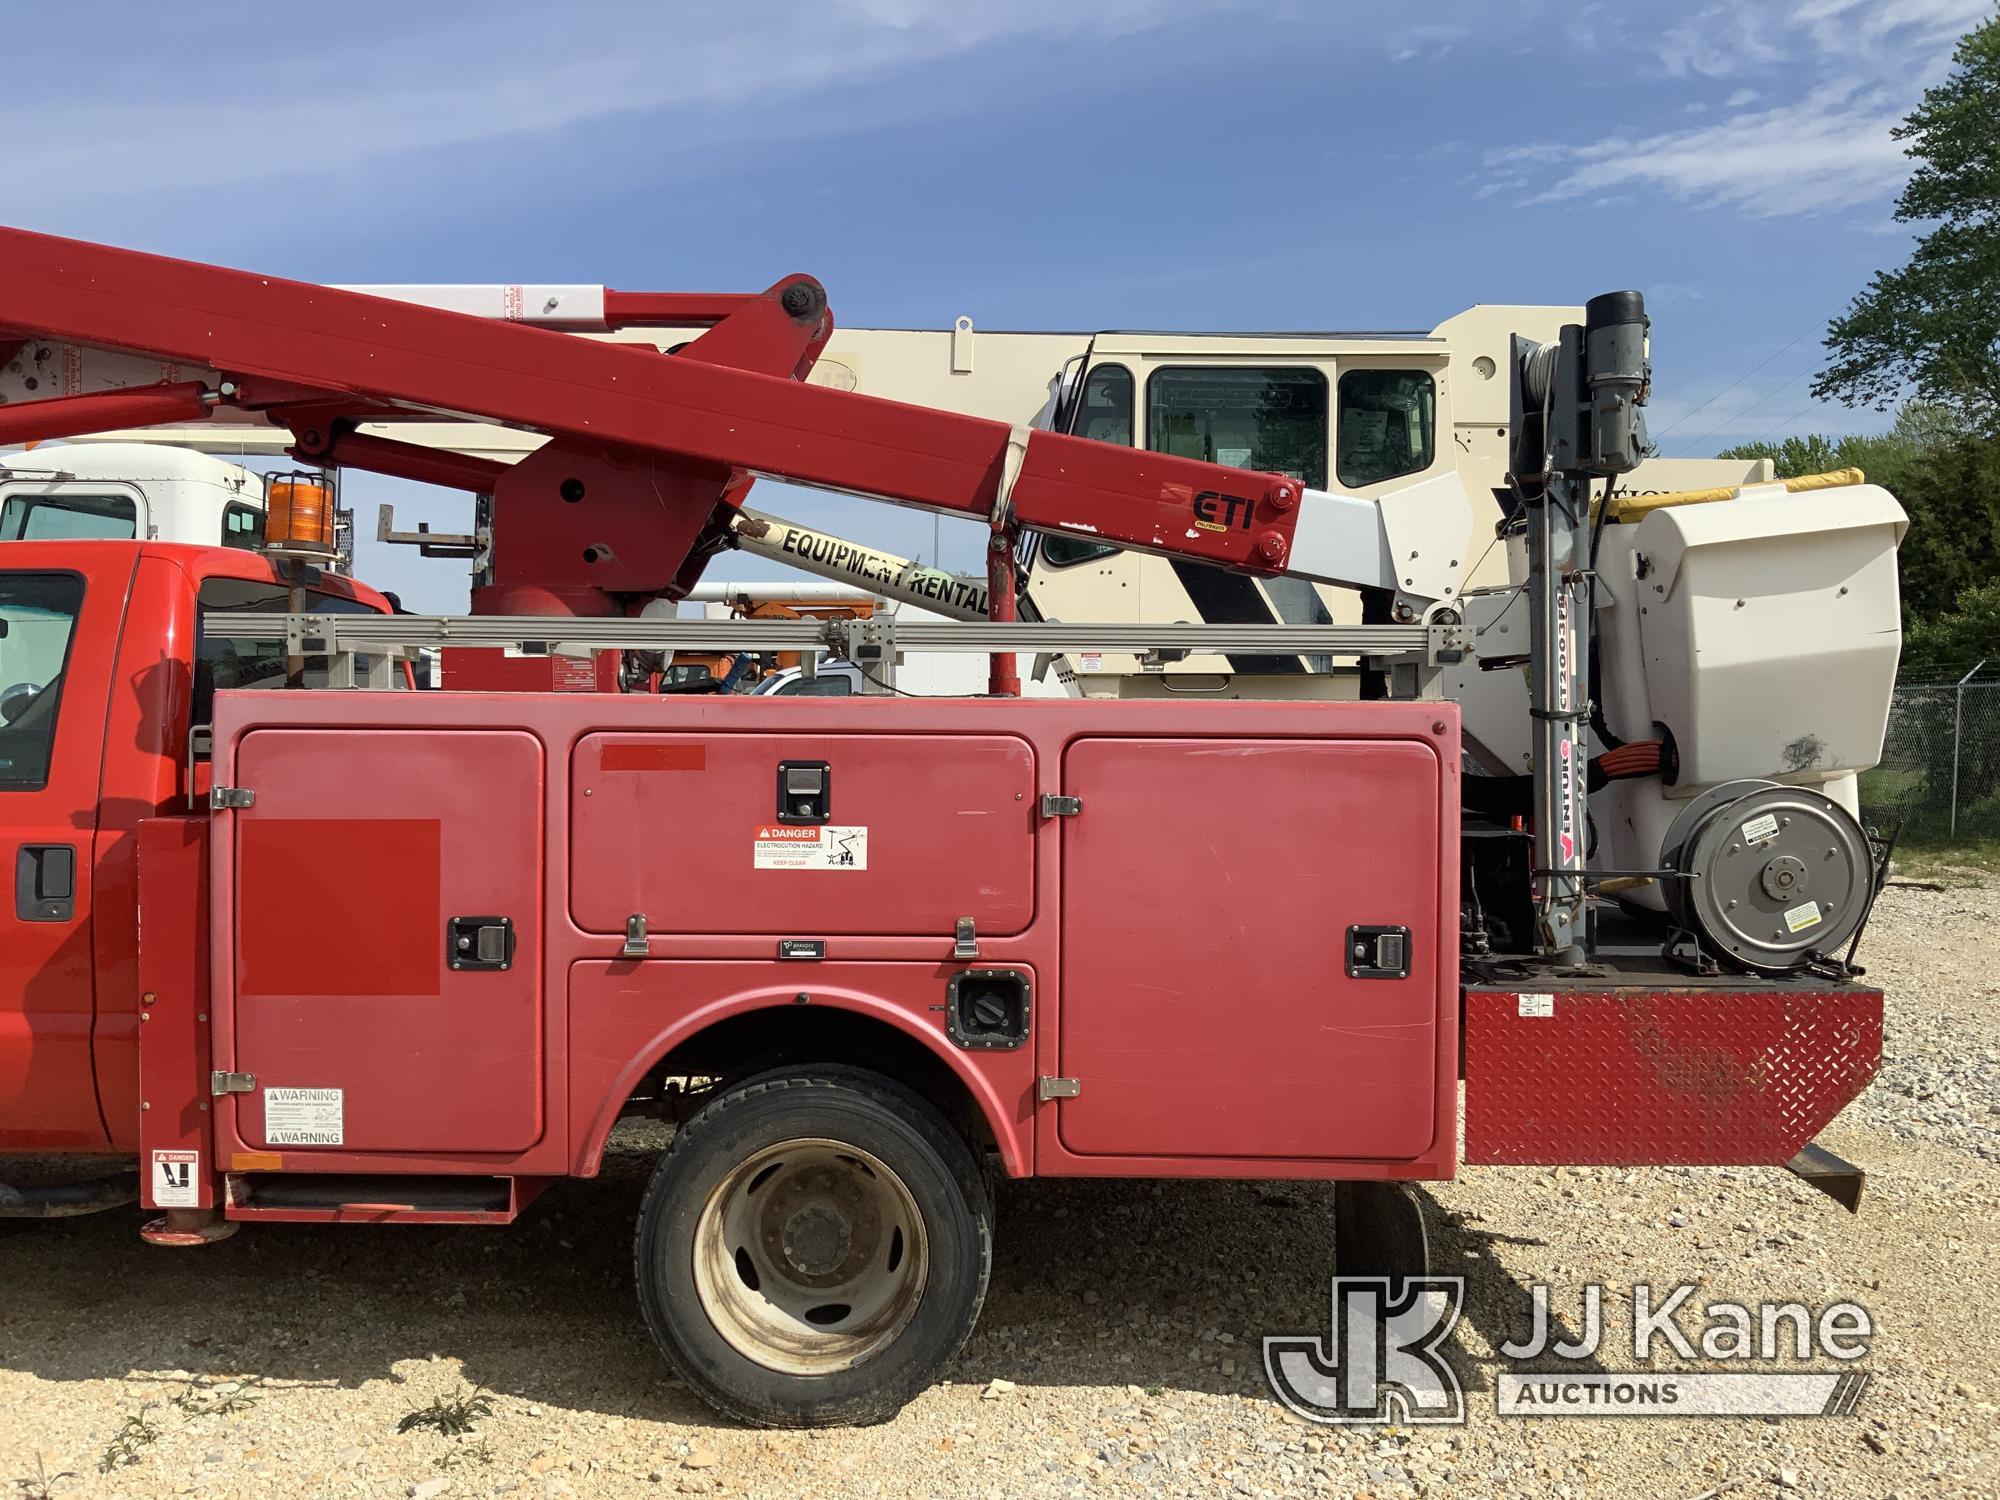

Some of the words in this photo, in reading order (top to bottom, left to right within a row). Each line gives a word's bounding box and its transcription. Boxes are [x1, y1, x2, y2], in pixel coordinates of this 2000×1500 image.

[1193, 490, 1255, 530] ETI
[1197, 521, 1225, 531] PALFINGER
[782, 529, 909, 588] EQUIPMENT
[909, 571, 989, 616] RENTAL
[771, 829, 816, 838] DANGER
[280, 1090, 339, 1101] WARNING
[281, 1132, 340, 1143] WARNING
